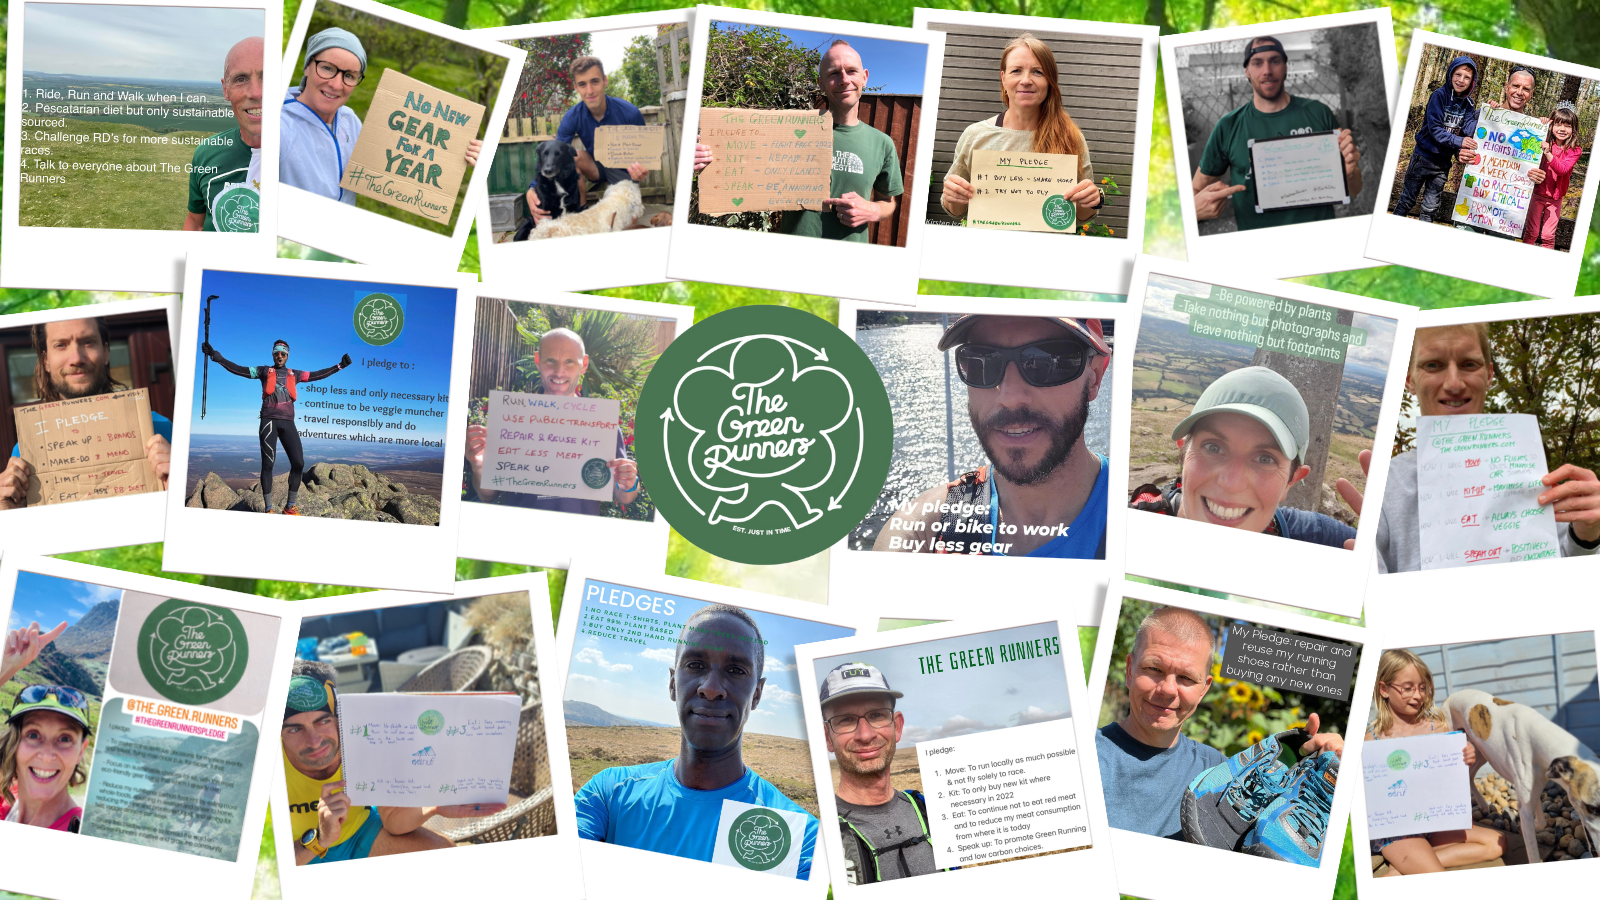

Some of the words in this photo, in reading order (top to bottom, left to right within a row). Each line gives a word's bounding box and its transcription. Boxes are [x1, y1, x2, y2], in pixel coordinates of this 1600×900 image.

[721, 113, 745, 124] THE
[750, 114, 783, 125] GREEN
[785, 115, 826, 125] RUNNERS
[388, 111, 450, 150] GEAR
[727, 141, 756, 150] MOVE
[1483, 142, 1511, 156] FLIGHTS
[422, 149, 434, 161] A
[726, 155, 745, 163] KIT
[385, 149, 442, 189] YEAR
[725, 167, 745, 176] EAT
[764, 167, 788, 175] ONLY
[1480, 166, 1485, 174] A
[1487, 169, 1508, 180] WEEK
[350, 166, 448, 218] #TheGreenRunners
[1492, 180, 1511, 194] RACE
[1514, 186, 1531, 199] TEES
[1473, 187, 1490, 198] BUY
[1492, 192, 1525, 210] ETHICAL
[1471, 201, 1508, 219] PROMOTE
[1466, 213, 1493, 226] ACTION
[502, 395, 526, 407] RUN,
[528, 399, 560, 410] WALK,
[563, 402, 597, 412] CYCLE
[35, 421, 49, 435] I
[56, 411, 114, 429] PLEDGE:
[1433, 420, 1451, 432] MY
[1469, 417, 1506, 428] PLEDGE
[47, 440, 78, 451] SPEAK
[82, 436, 92, 444] UP
[107, 431, 136, 441] BRANDS
[525, 449, 549, 457] LESS
[50, 456, 90, 467] MAKE-DO
[496, 462, 530, 471] SPEAK
[535, 465, 549, 473] UP
[54, 475, 80, 484] LIMIT
[492, 476, 576, 489] #TheGreenRunners
[59, 492, 79, 500] EAT
